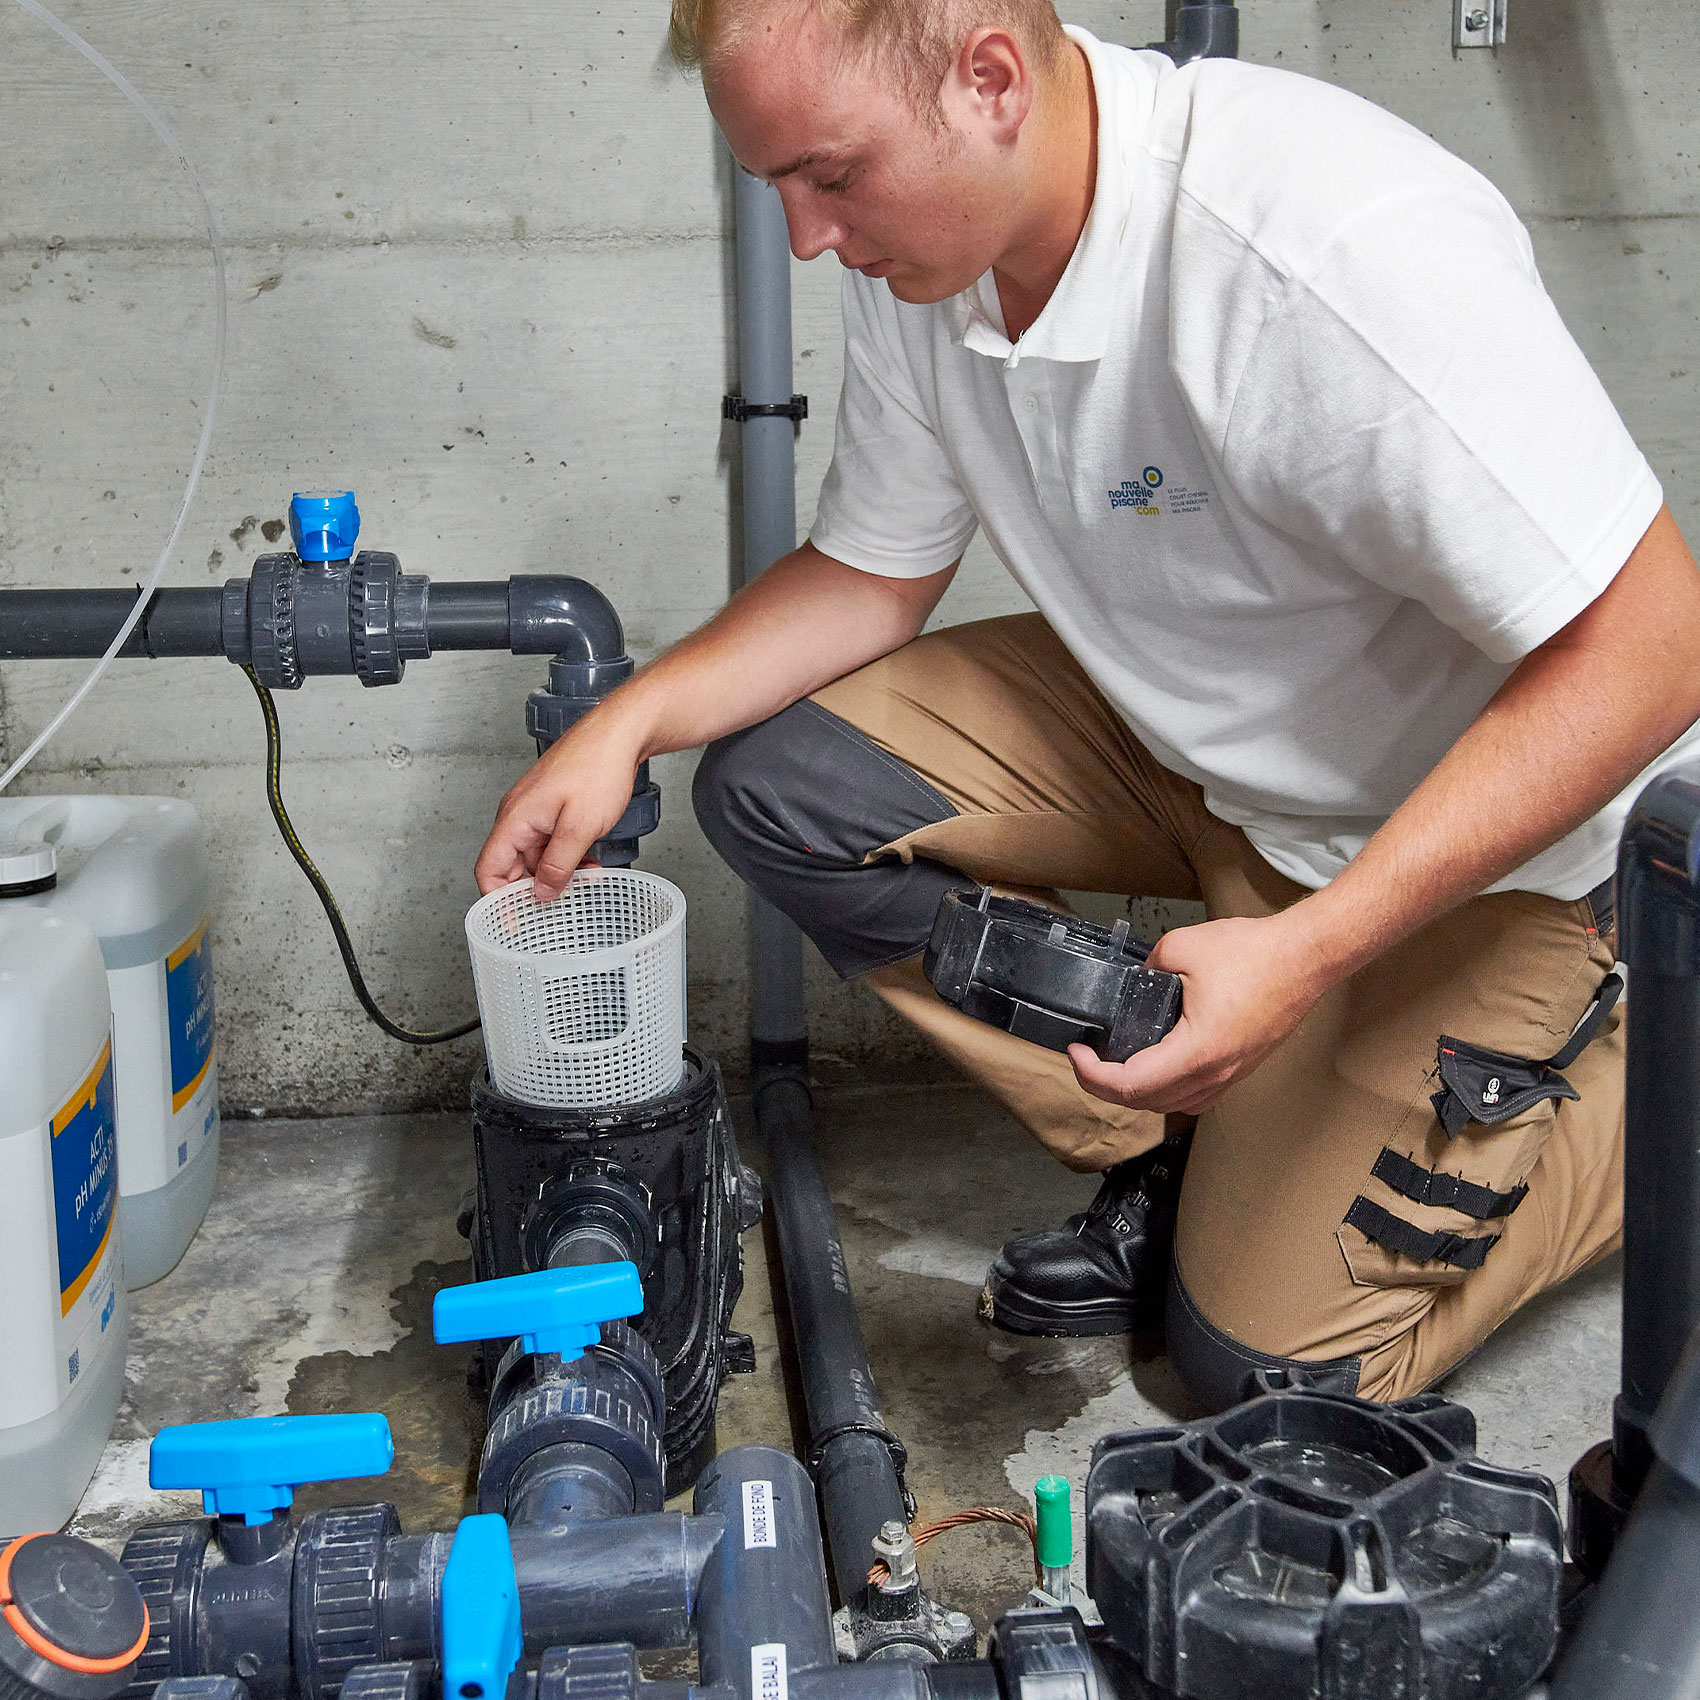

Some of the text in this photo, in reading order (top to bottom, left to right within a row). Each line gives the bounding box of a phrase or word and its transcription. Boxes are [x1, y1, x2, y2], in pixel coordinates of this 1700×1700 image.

[1108, 487, 1154, 498] nouvelle
[1121, 481, 1140, 490] ma
[1111, 497, 1149, 510] piscine
[91, 1124, 104, 1165] ACTI
[75, 1180, 88, 1220] pH
[90, 1147, 108, 1196] MINUS
[751, 1484, 767, 1543] BONDE DE FOND
[762, 1656, 778, 1688] BALAI
